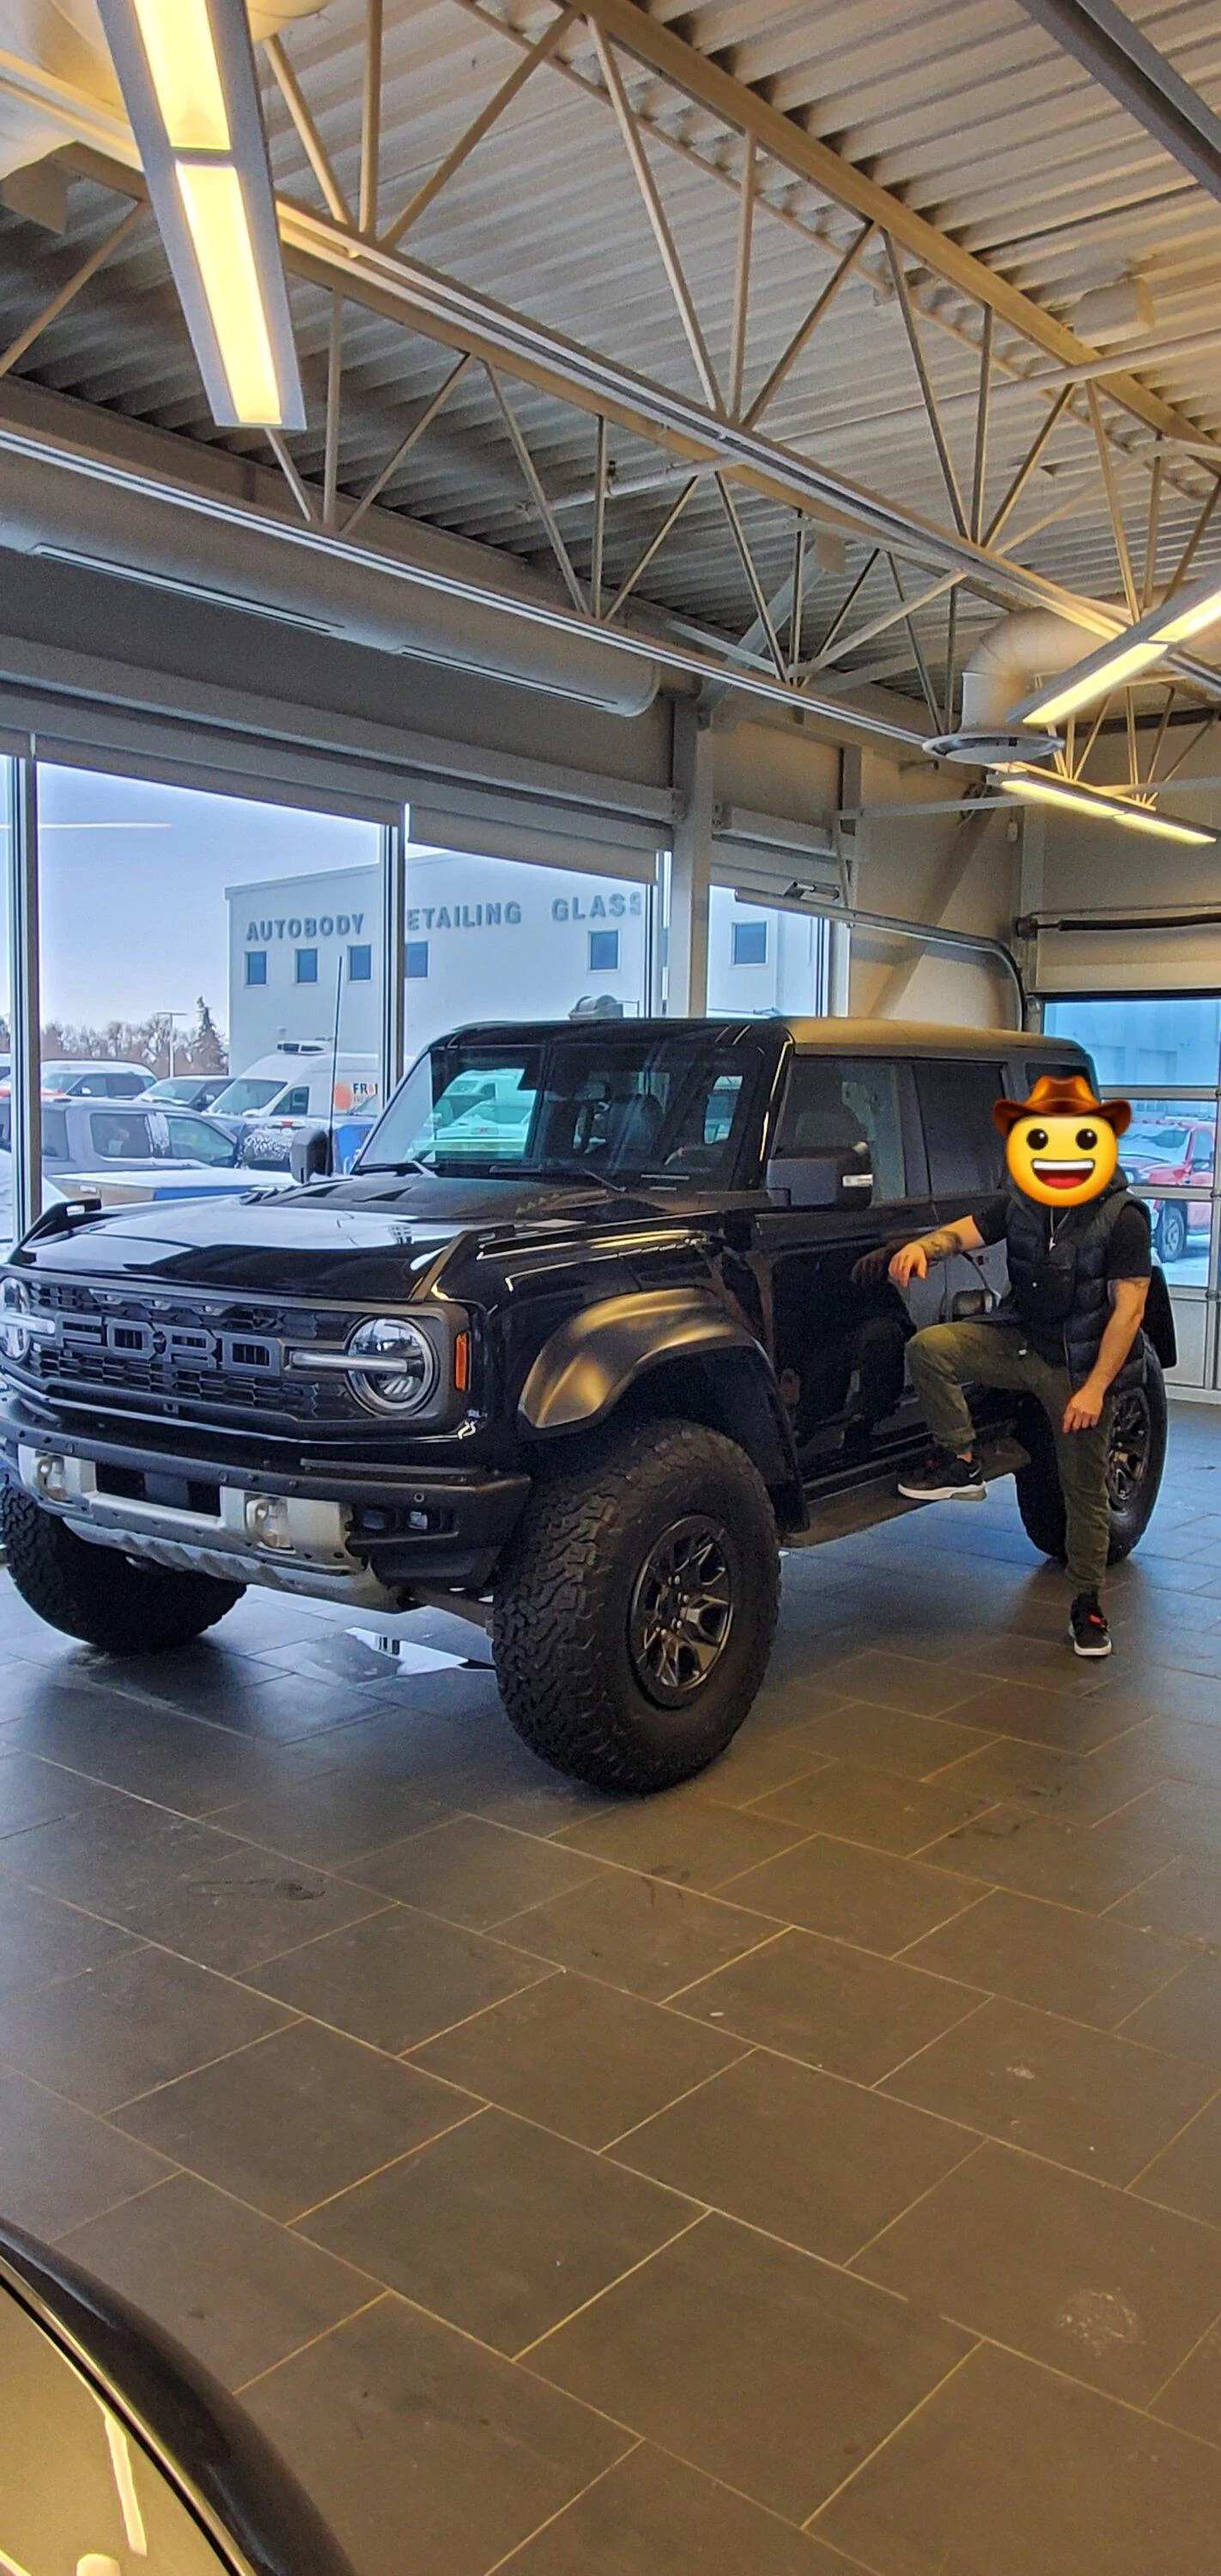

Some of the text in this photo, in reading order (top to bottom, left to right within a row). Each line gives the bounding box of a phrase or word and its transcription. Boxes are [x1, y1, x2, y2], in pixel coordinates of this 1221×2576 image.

[246, 891, 641, 941] AUTOBODY ETAILING GLASS
[56, 1313, 282, 1376] FORD
